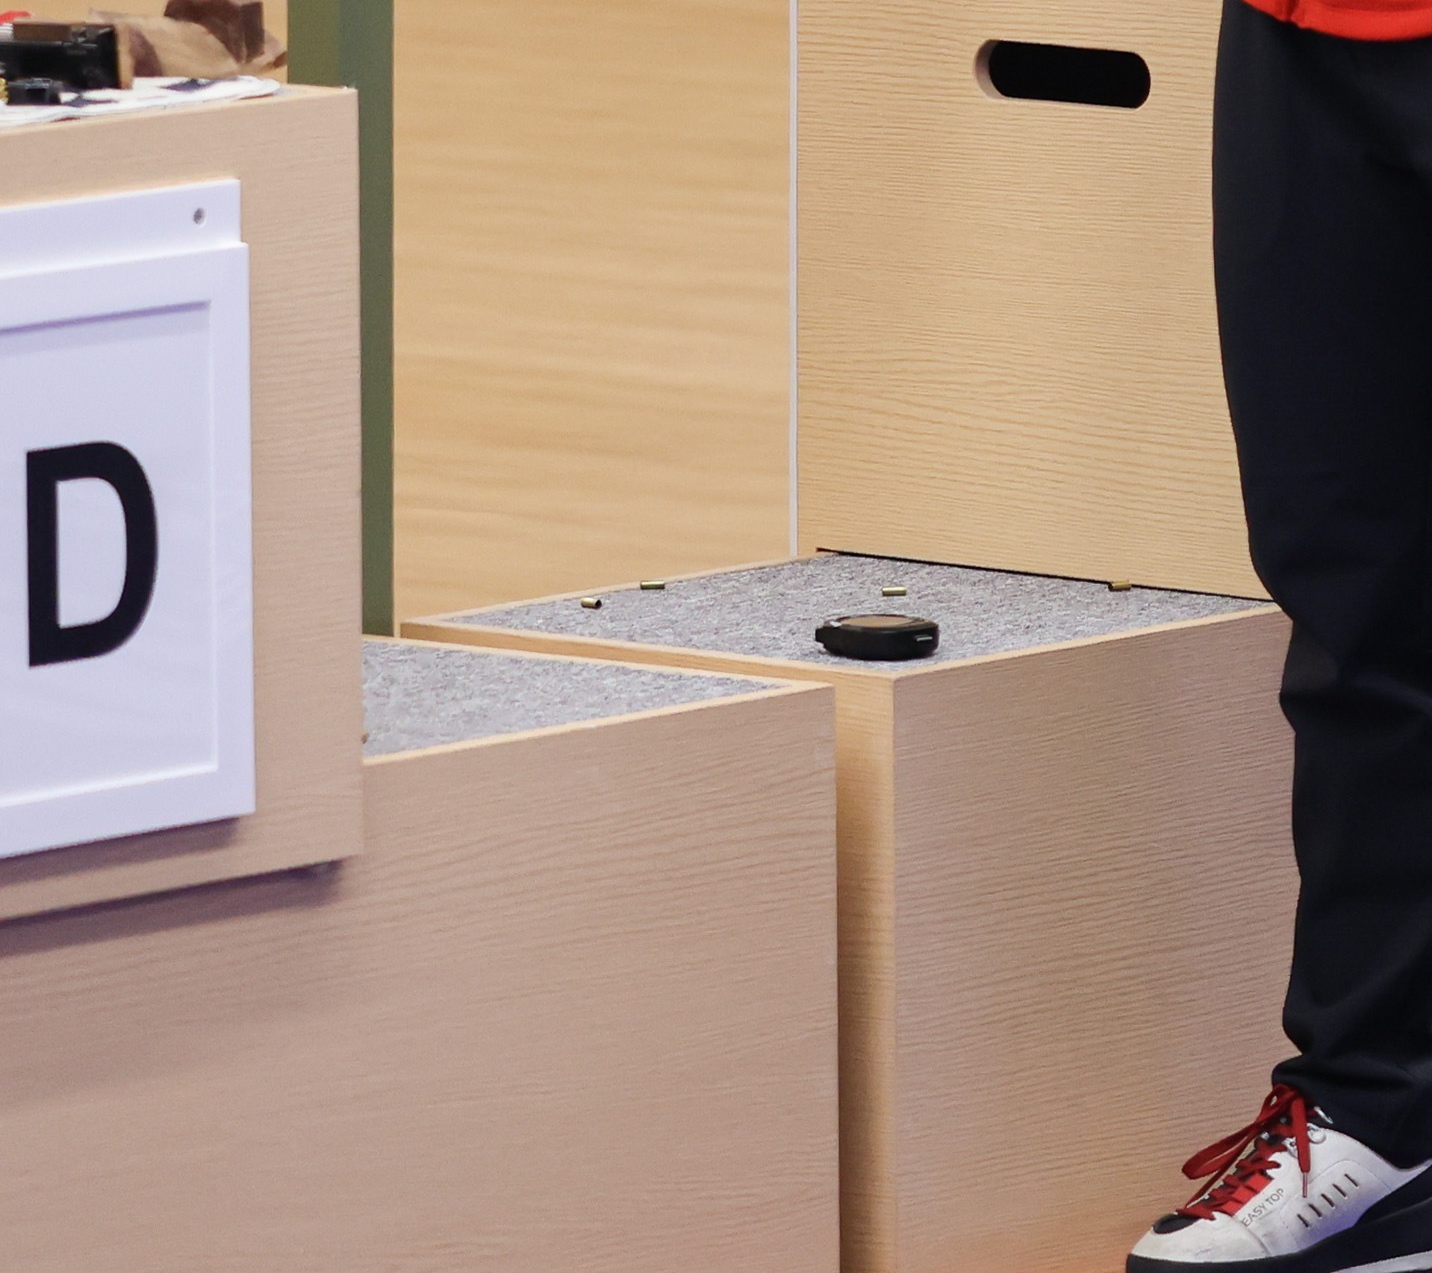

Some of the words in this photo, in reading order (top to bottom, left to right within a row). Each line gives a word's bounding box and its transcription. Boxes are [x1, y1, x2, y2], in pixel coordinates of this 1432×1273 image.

[27, 441, 158, 667] D
[1241, 1202, 1268, 1227] EASY
[1265, 1187, 1285, 1206] TOP
